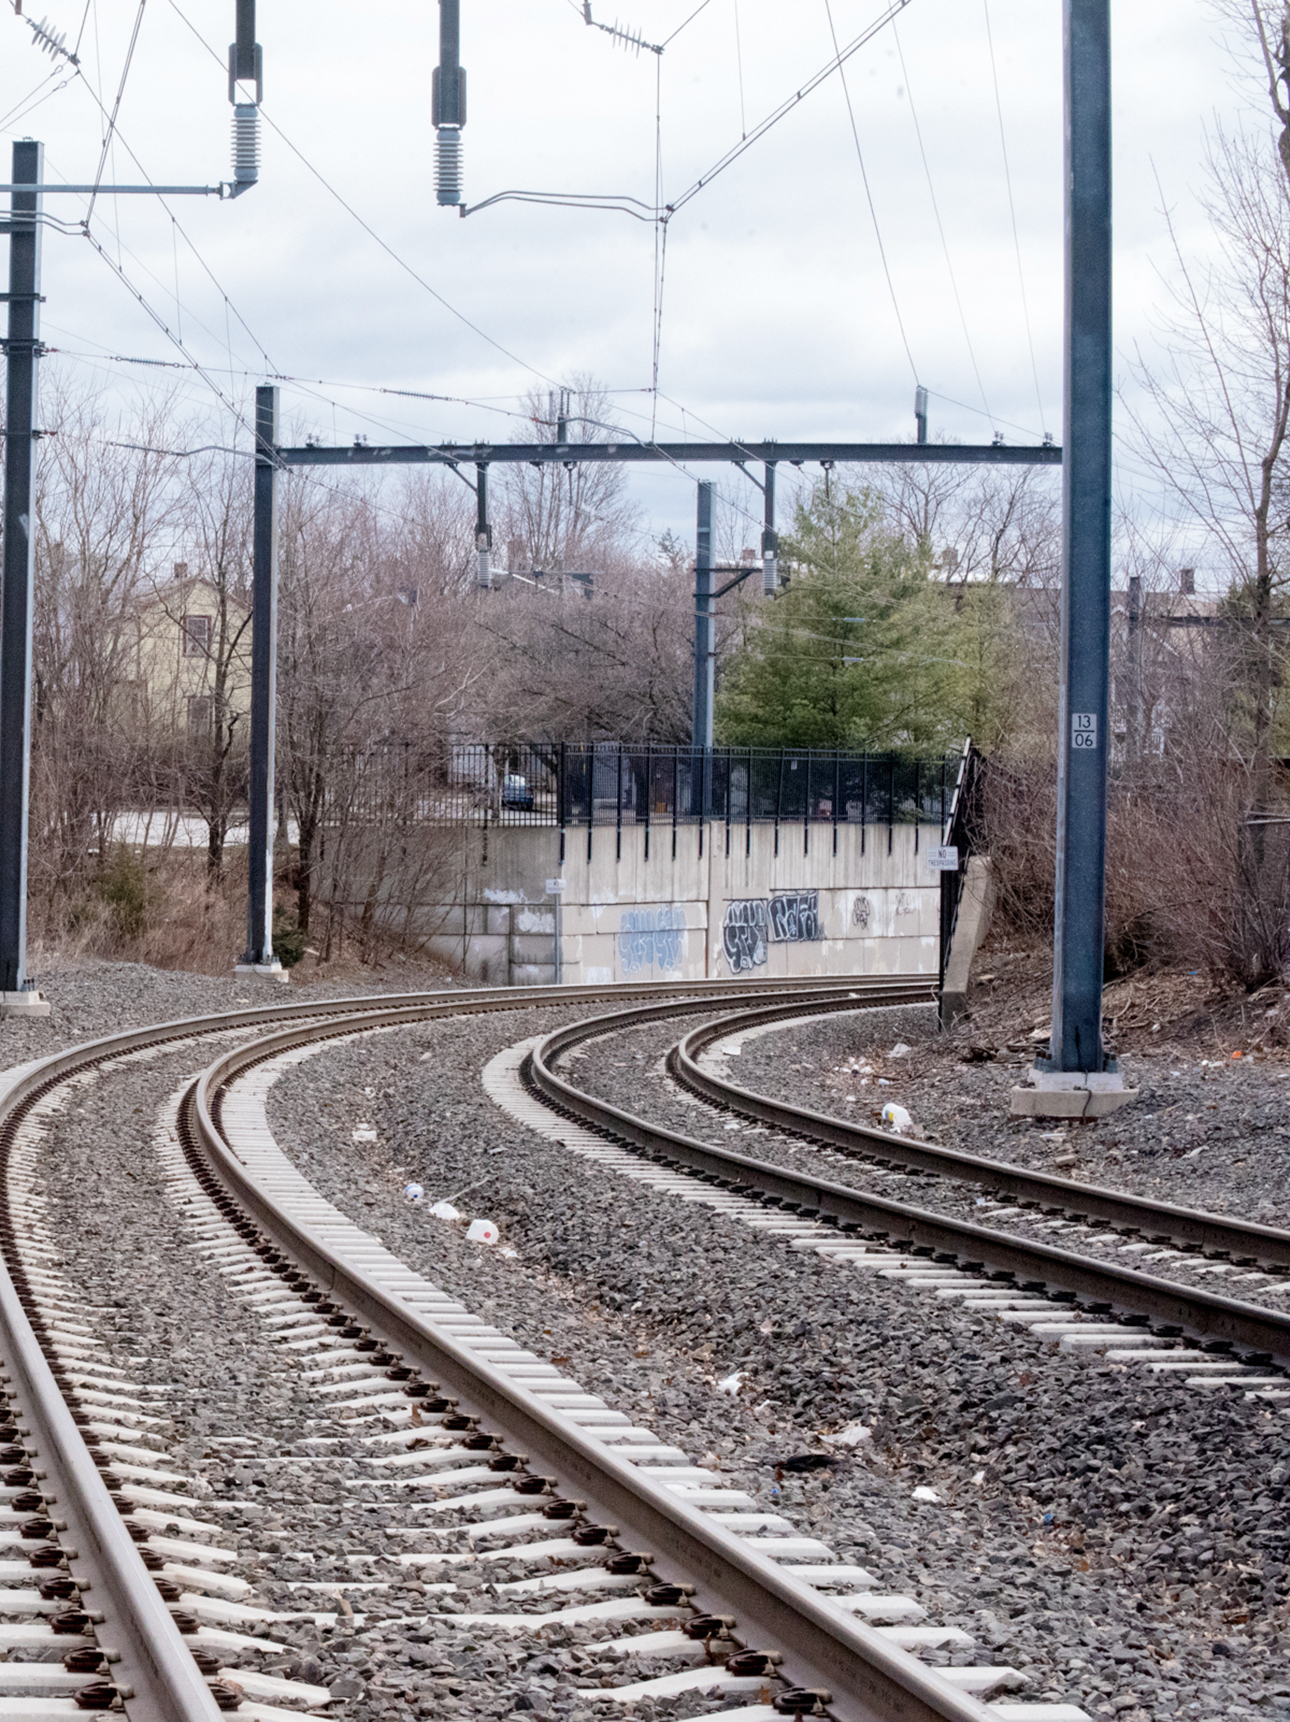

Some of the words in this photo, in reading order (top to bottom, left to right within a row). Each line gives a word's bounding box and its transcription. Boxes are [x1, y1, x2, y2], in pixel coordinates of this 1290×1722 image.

[1078, 715, 1091, 728] 13
[1075, 733, 1093, 747] 06
[938, 850, 946, 858] NO
